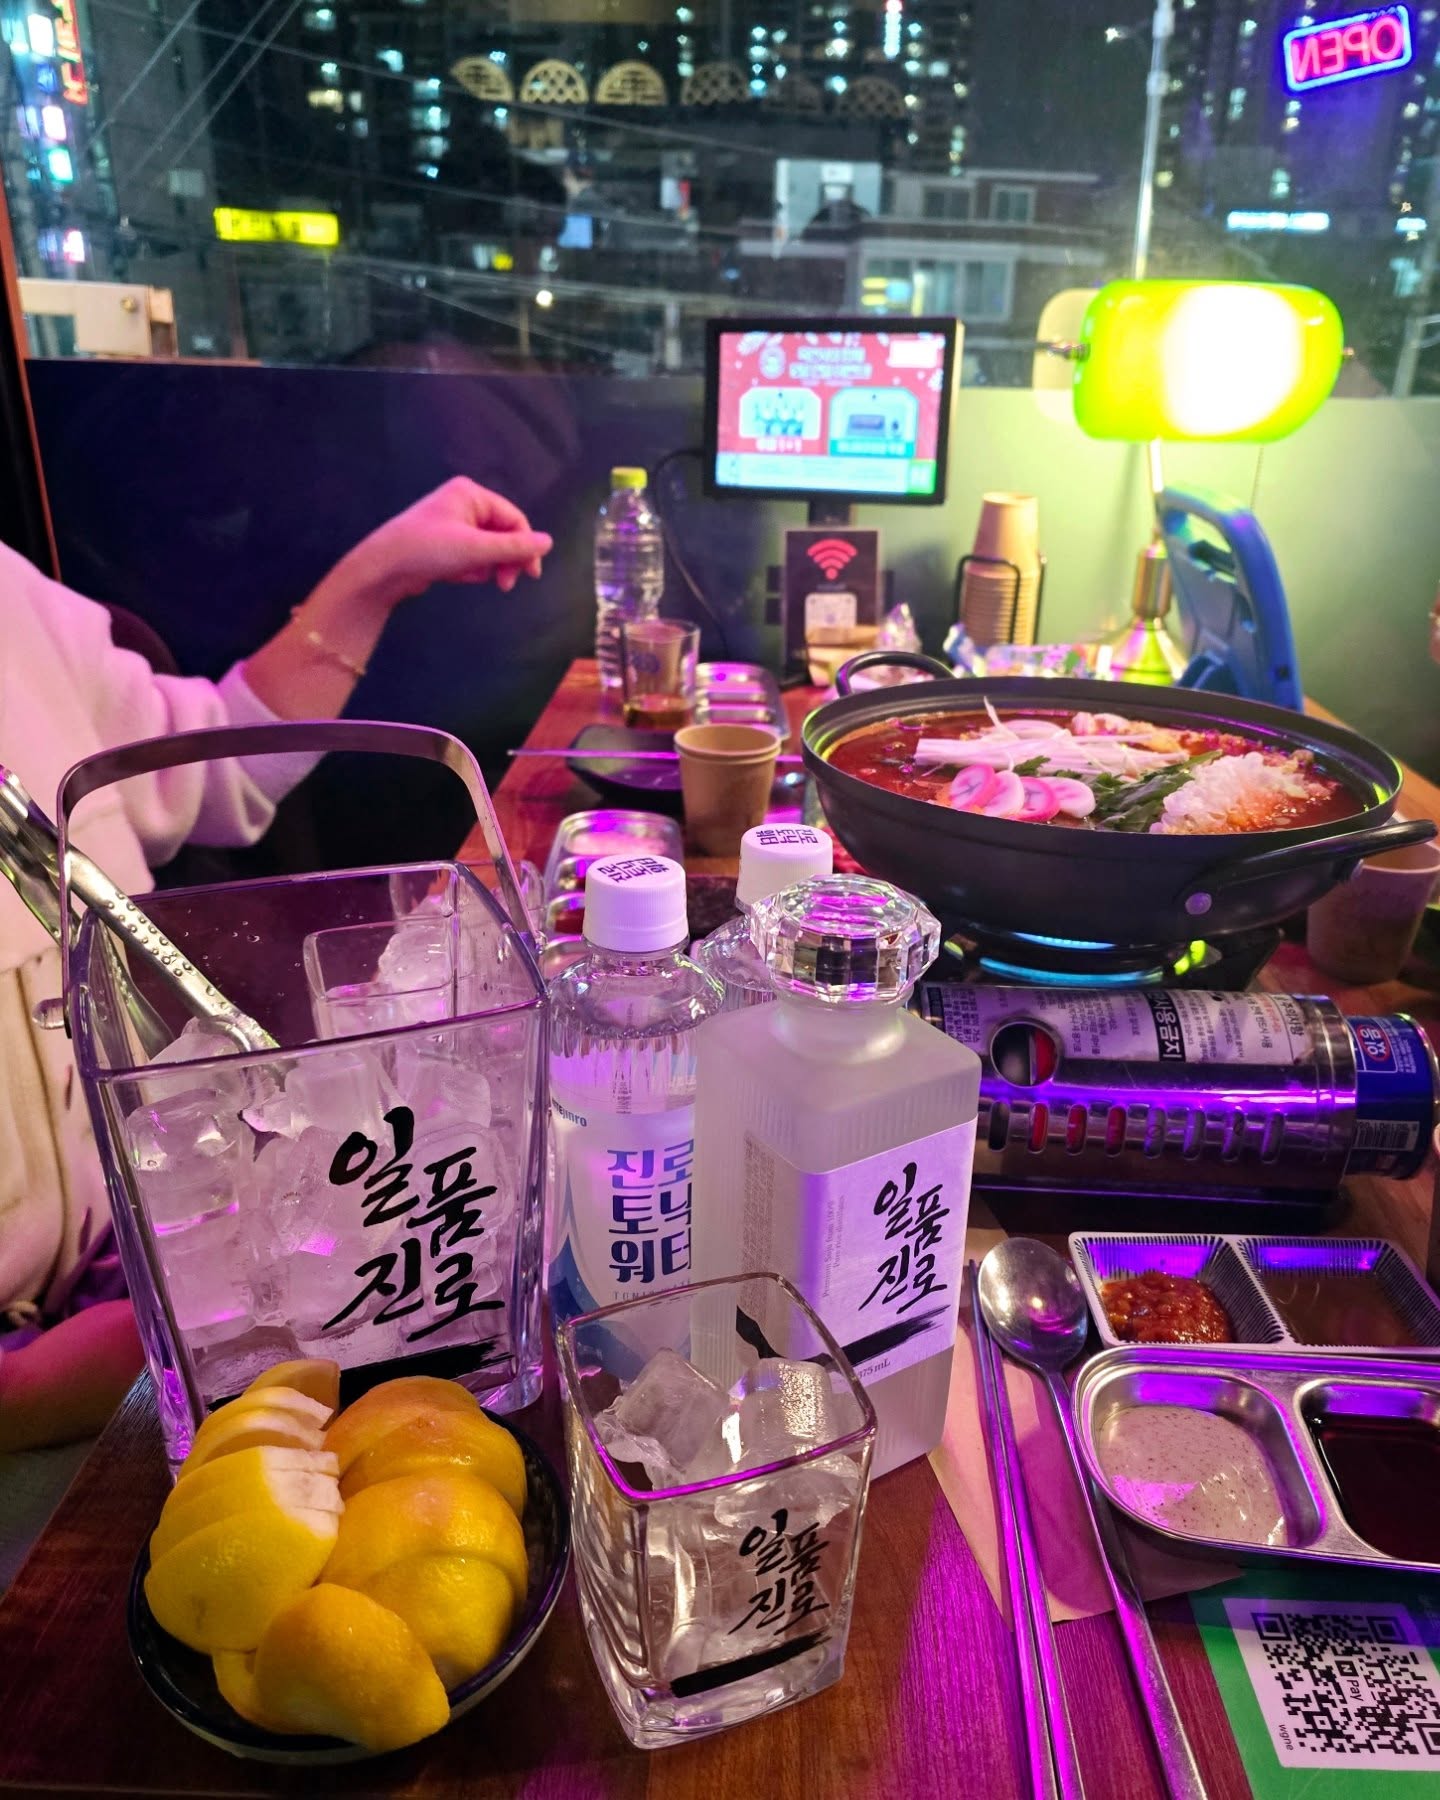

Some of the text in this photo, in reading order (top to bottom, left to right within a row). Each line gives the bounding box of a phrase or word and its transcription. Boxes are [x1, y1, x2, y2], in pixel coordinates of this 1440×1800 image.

[1359, 1028, 1386, 1055] 있음
[328, 1105, 498, 1257] 일품
[607, 1138, 694, 1190] 진로
[608, 1182, 692, 1235] 토닉
[873, 1161, 951, 1254] 일품
[608, 1227, 692, 1284] 워터
[823, 1244, 834, 1263] Soju
[858, 1243, 949, 1314] 진로
[321, 1241, 506, 1343] 진로
[738, 1509, 831, 1585] 일품
[729, 1579, 831, 1635] 진로
[1347, 1679, 1364, 1702] Pay
[1278, 1724, 1296, 1751] wgne
